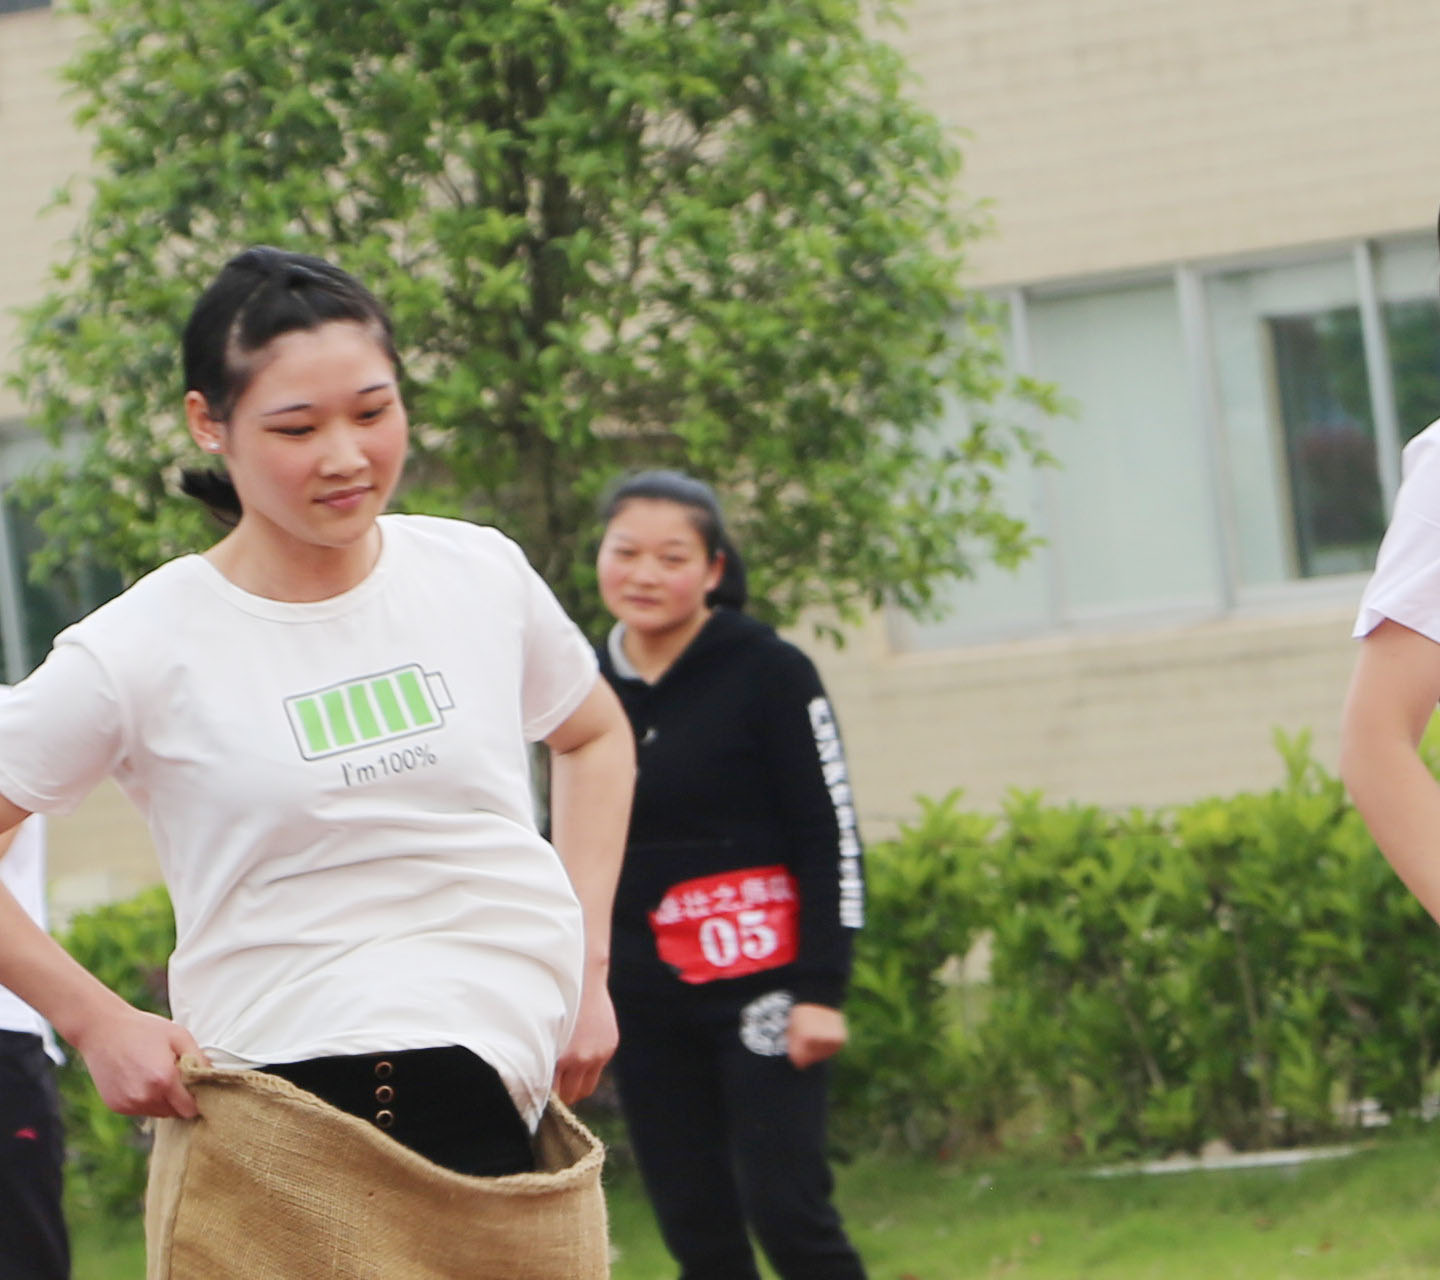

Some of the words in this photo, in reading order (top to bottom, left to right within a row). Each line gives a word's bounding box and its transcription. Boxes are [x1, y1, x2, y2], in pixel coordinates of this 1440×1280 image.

[340, 761, 377, 787] I'm
[380, 743, 438, 775] 100%
[698, 909, 779, 968] 05
